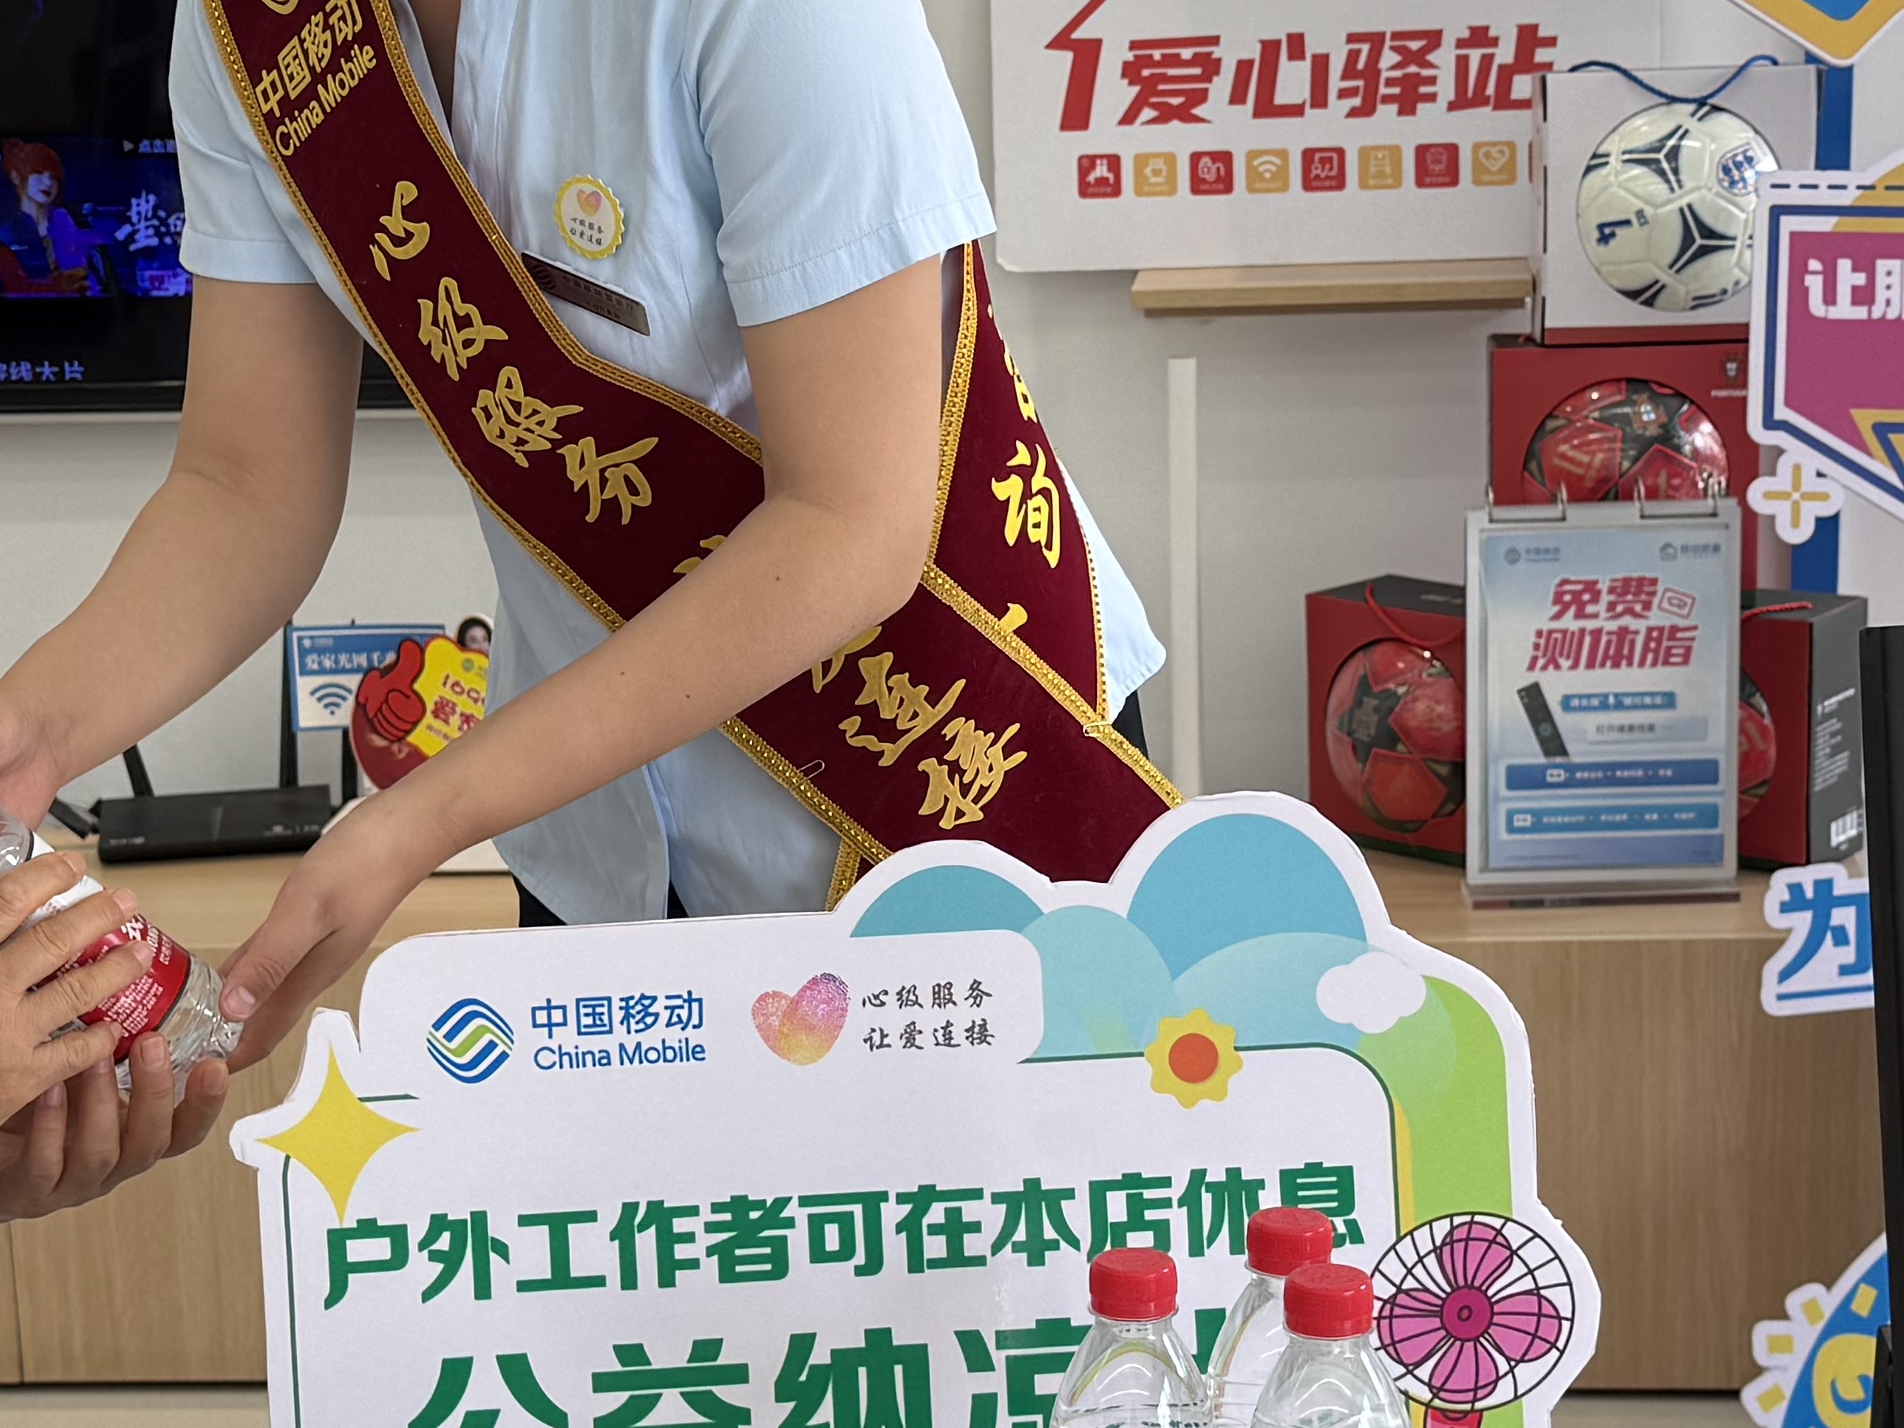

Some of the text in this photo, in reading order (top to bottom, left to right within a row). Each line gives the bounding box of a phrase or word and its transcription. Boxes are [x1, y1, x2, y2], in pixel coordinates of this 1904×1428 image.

[1116, 22, 1558, 127] 爱心驿站
[275, 44, 377, 158] China Mobile
[1547, 575, 1659, 621] 免费
[1525, 624, 1699, 673] 测体脂
[531, 990, 704, 1040] 中国移动
[862, 979, 994, 1012] 心级服务
[534, 1039, 706, 1070] China Mobile
[863, 1018, 996, 1053] 让爱连接
[324, 1160, 1364, 1310] 户外工作者可在本店休息
